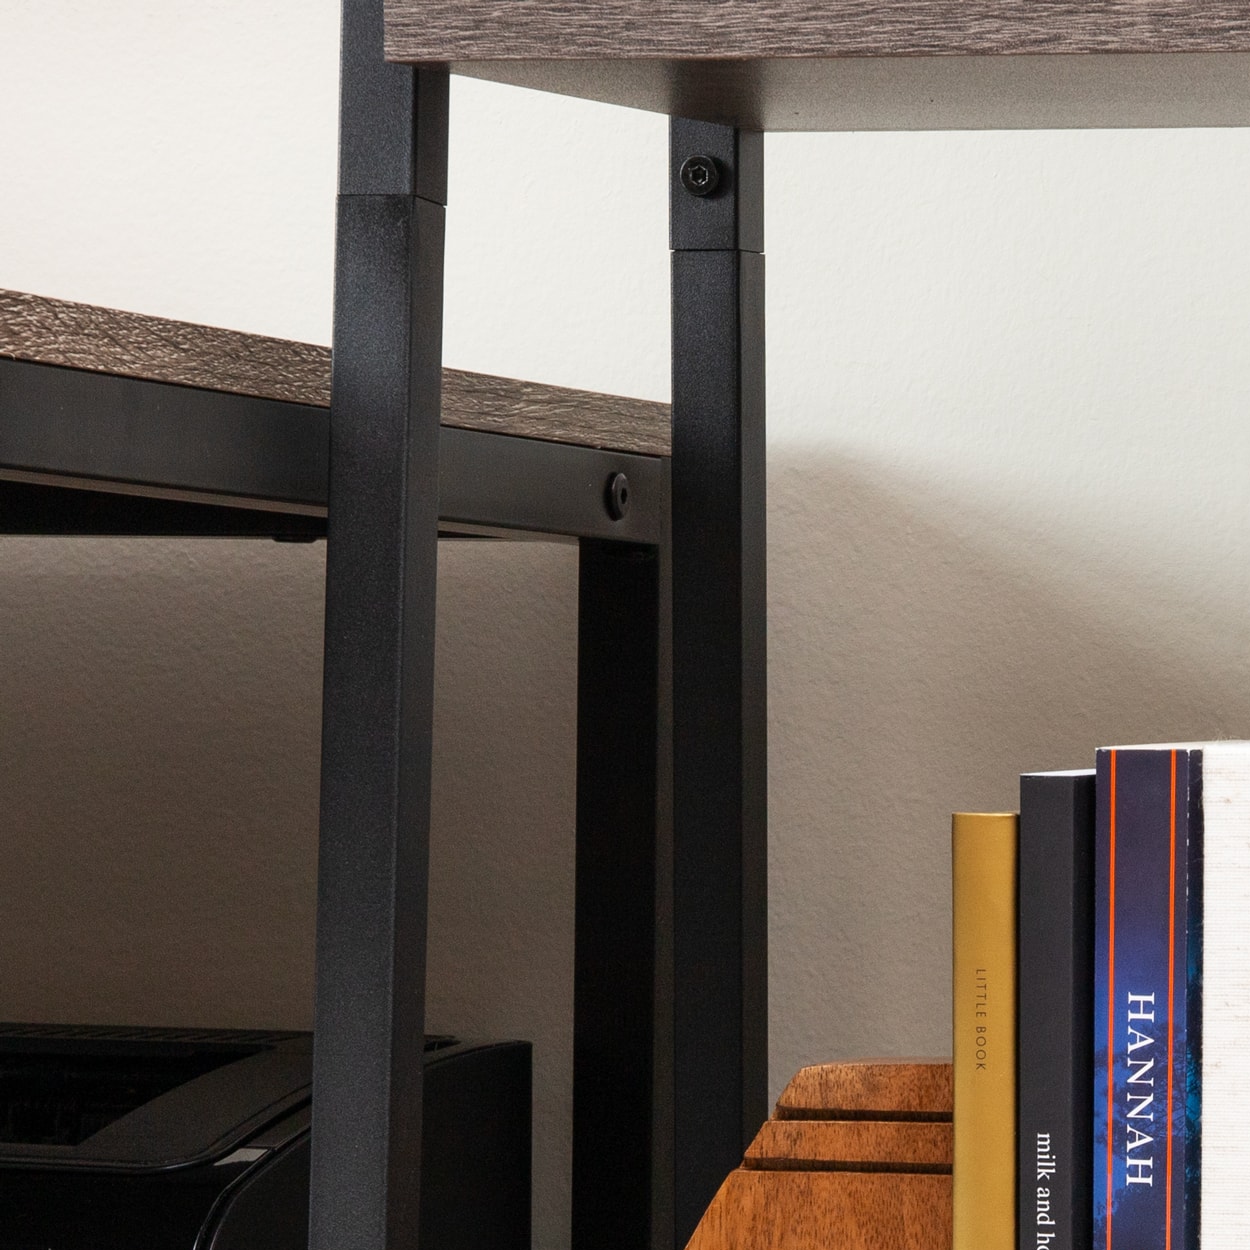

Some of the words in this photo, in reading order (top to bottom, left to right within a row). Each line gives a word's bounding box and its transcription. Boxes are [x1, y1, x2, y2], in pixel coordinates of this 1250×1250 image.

[975, 969, 987, 1018] LITTLE
[975, 1026, 987, 1070] BOOK
[1126, 992, 1155, 1187] HANNAH
[1036, 1132, 1056, 1181] milk
[1036, 1187, 1055, 1226] and
